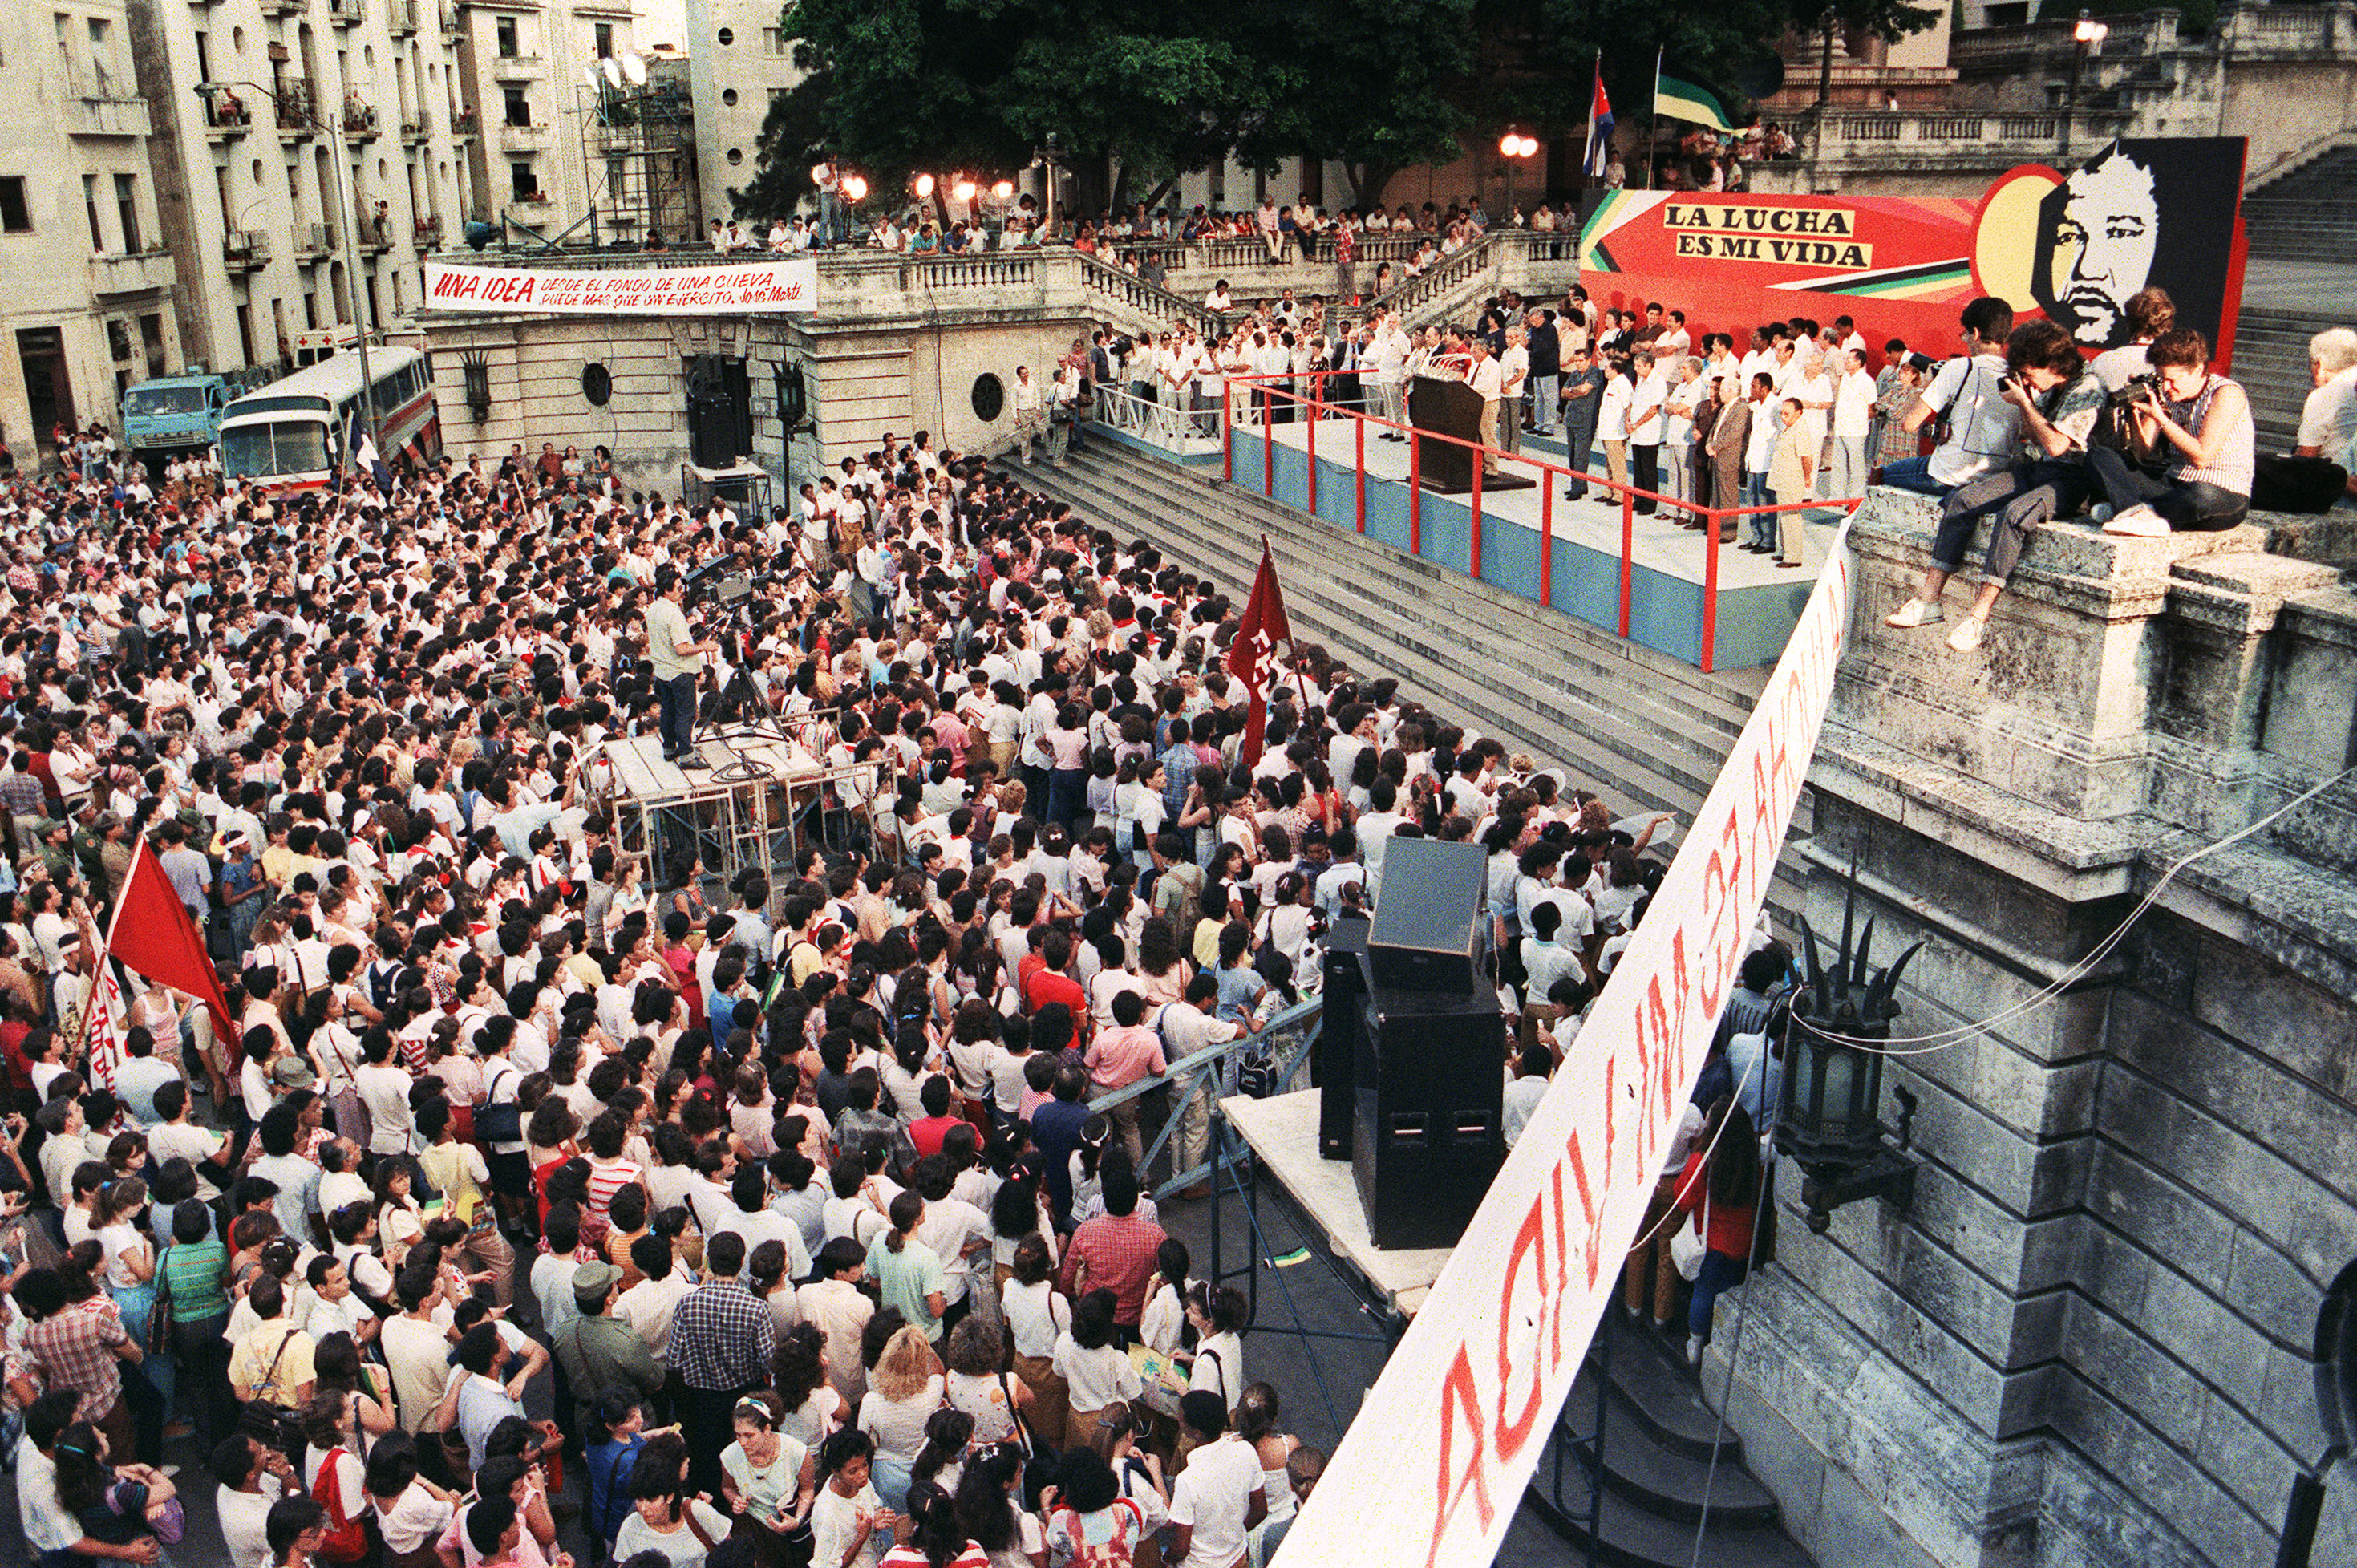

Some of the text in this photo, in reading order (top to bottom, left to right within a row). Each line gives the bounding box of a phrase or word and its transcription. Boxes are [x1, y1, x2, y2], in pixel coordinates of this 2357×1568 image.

[1666, 206, 1850, 234] LA LUCHA
[1678, 235, 1868, 267] ES MI VIDA
[434, 273, 536, 302] UNA IDEA
[541, 272, 774, 292] DESDE EL FONDO DE UNA CUEVA
[541, 293, 581, 306] PUEDE
[613, 294, 642, 309] QUE
